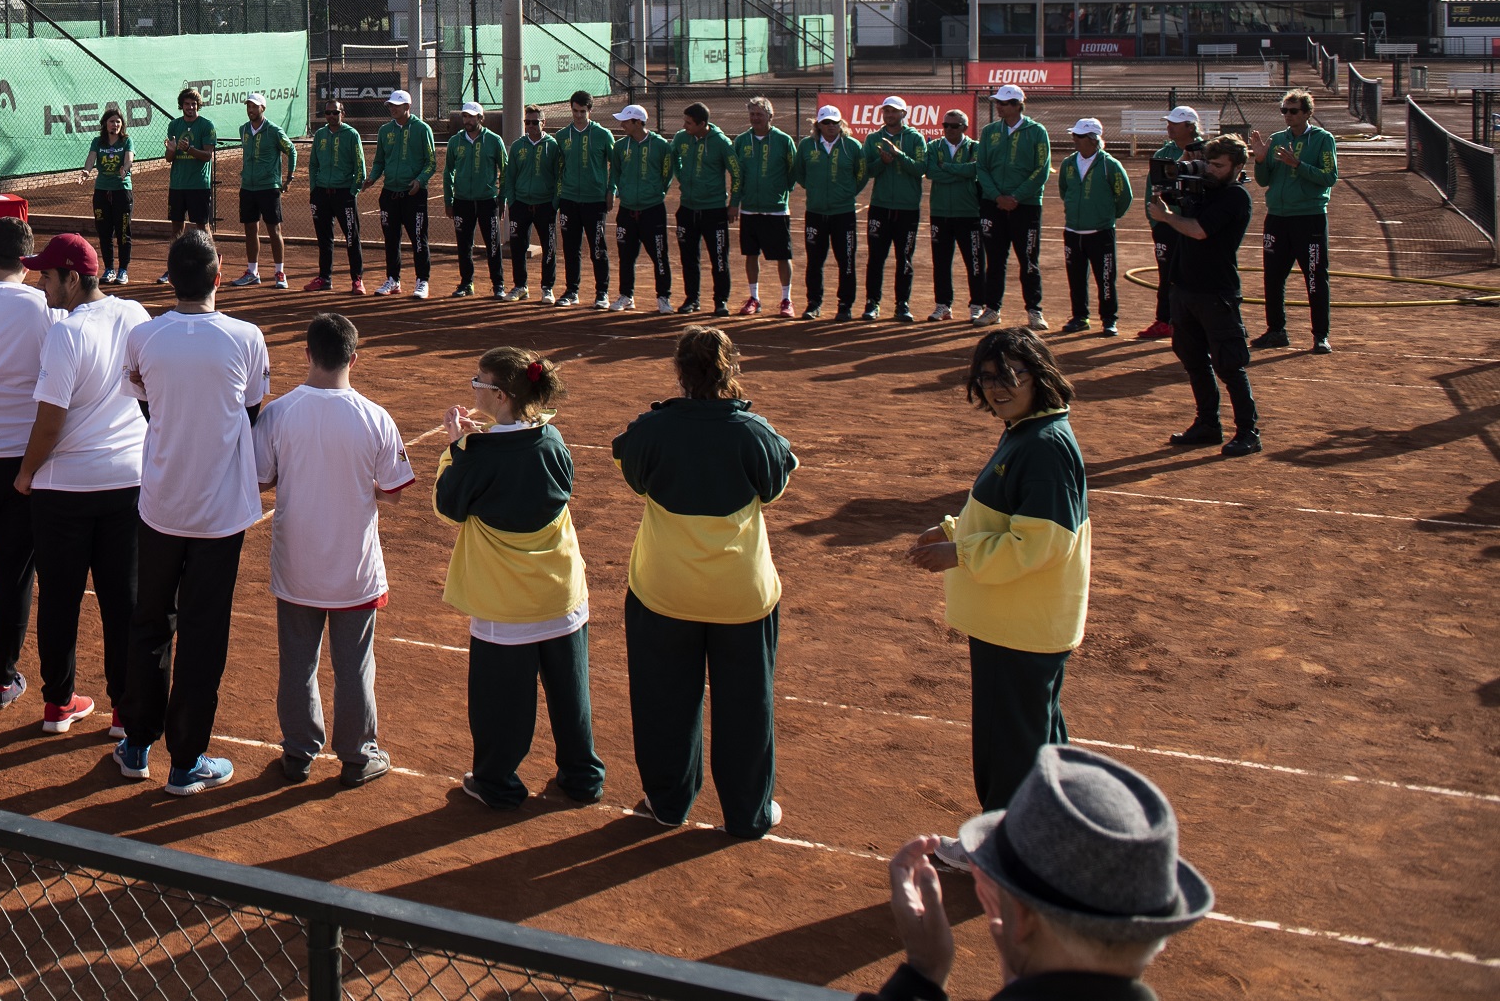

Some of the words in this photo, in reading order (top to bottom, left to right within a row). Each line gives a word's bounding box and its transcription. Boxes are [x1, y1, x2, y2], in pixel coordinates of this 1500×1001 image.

[1080, 43, 1119, 53] LEOTRON
[216, 75, 261, 88] academia
[988, 69, 1048, 83] LEOTRON
[321, 86, 396, 99] HEAD
[851, 104, 940, 126] LEORON
[535, 145, 543, 176] HEAD
[696, 143, 705, 176] HEAD
[761, 144, 769, 177] HEAD
[831, 148, 839, 182] HEAD
[1308, 243, 1317, 295] SANCHEZ-CASAL
